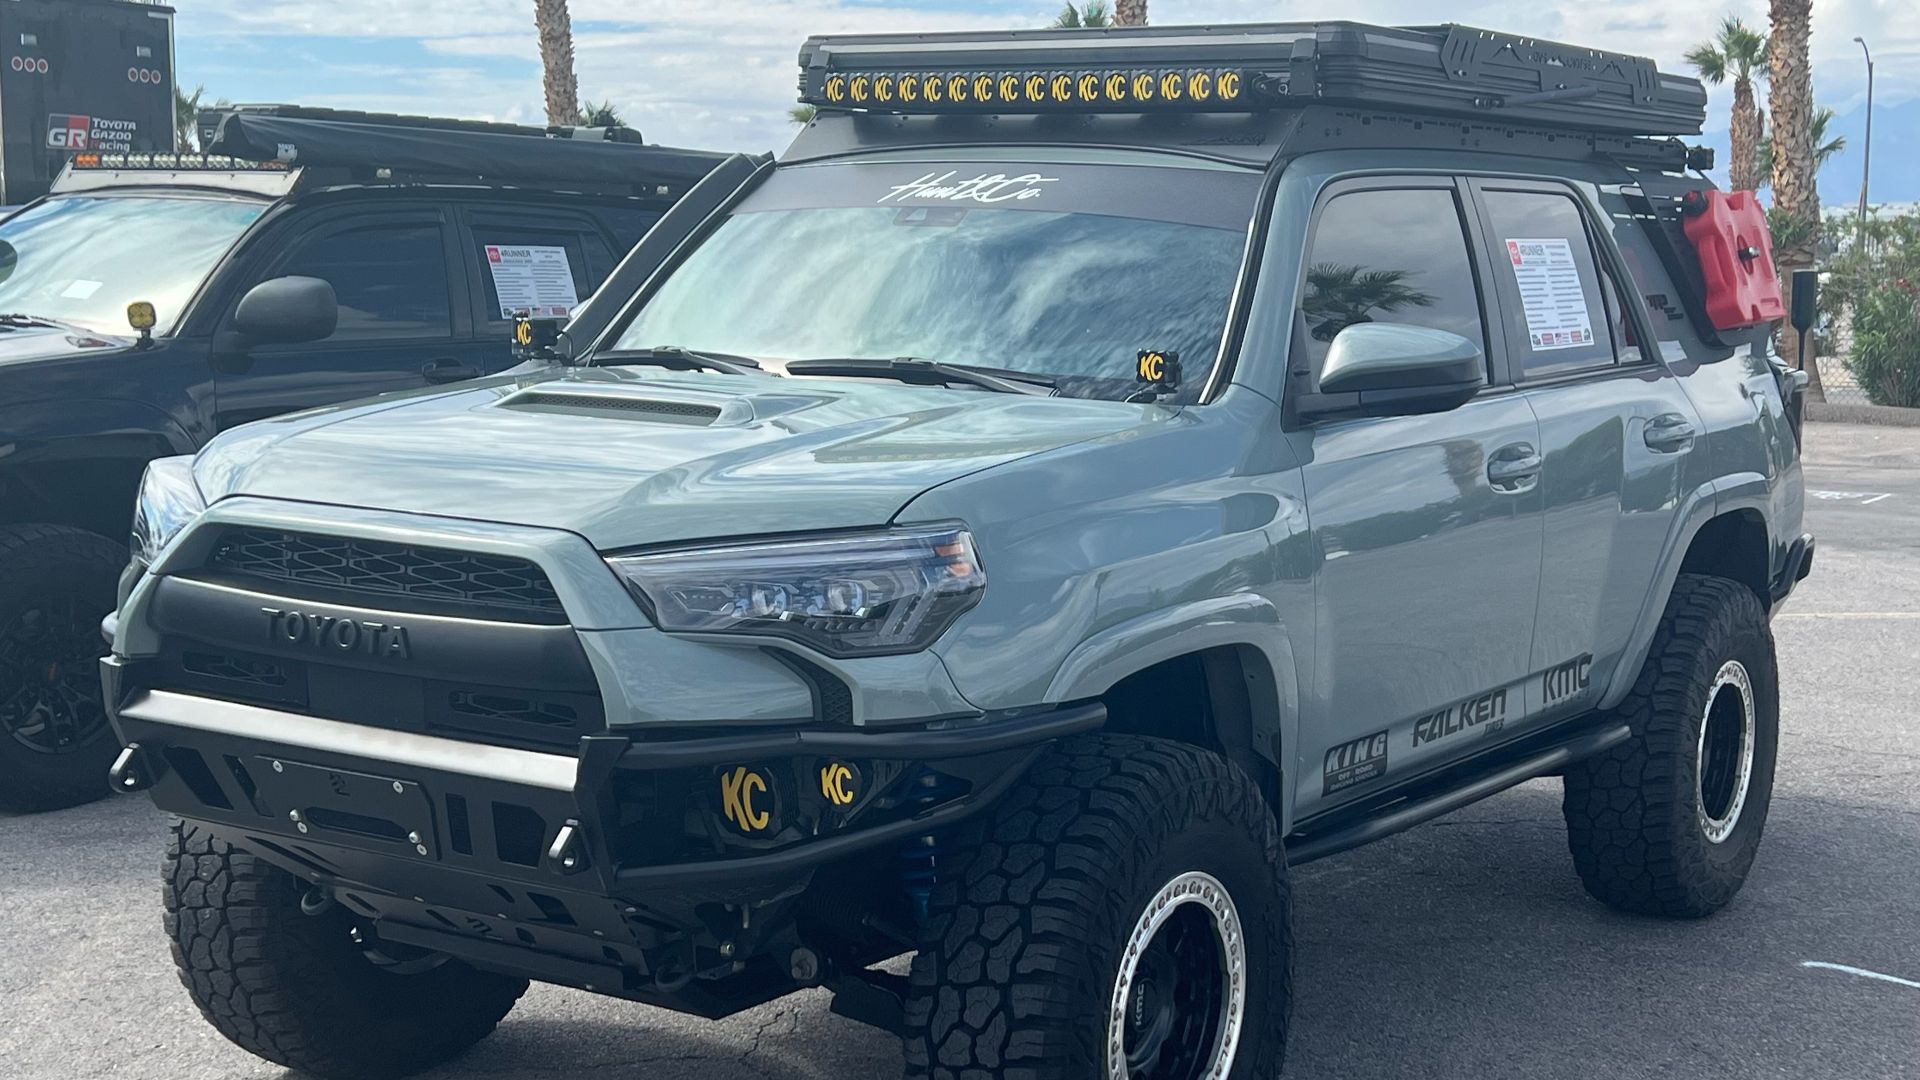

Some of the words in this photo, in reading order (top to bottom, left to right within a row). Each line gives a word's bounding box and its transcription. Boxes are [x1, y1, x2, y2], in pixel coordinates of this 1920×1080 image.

[827, 77, 844, 101] KC
[851, 77, 868, 101] KC
[875, 77, 892, 101] KC
[899, 77, 916, 101] KC
[924, 77, 941, 101] KC
[949, 77, 967, 101] KC
[974, 76, 992, 101] KC
[1000, 76, 1018, 101] KC
[1026, 76, 1045, 101] KC
[1052, 76, 1071, 101] KC
[1079, 75, 1098, 101] KC
[1106, 75, 1125, 101] KC
[1133, 74, 1153, 100] KC
[1161, 74, 1182, 100] KC
[1189, 73, 1210, 100] KC
[1218, 72, 1239, 99] KC
[48, 127, 86, 147] GR
[91, 129, 132, 141] GAZOO
[92, 117, 136, 130] TOYOTA
[517, 320, 531, 345] KC
[1140, 353, 1163, 381] KC
[261, 607, 413, 659] TOYOTA
[1412, 688, 1507, 748] FALKEN
[1325, 733, 1386, 774] KING
[721, 766, 769, 832] KC
[820, 763, 854, 805] KC
